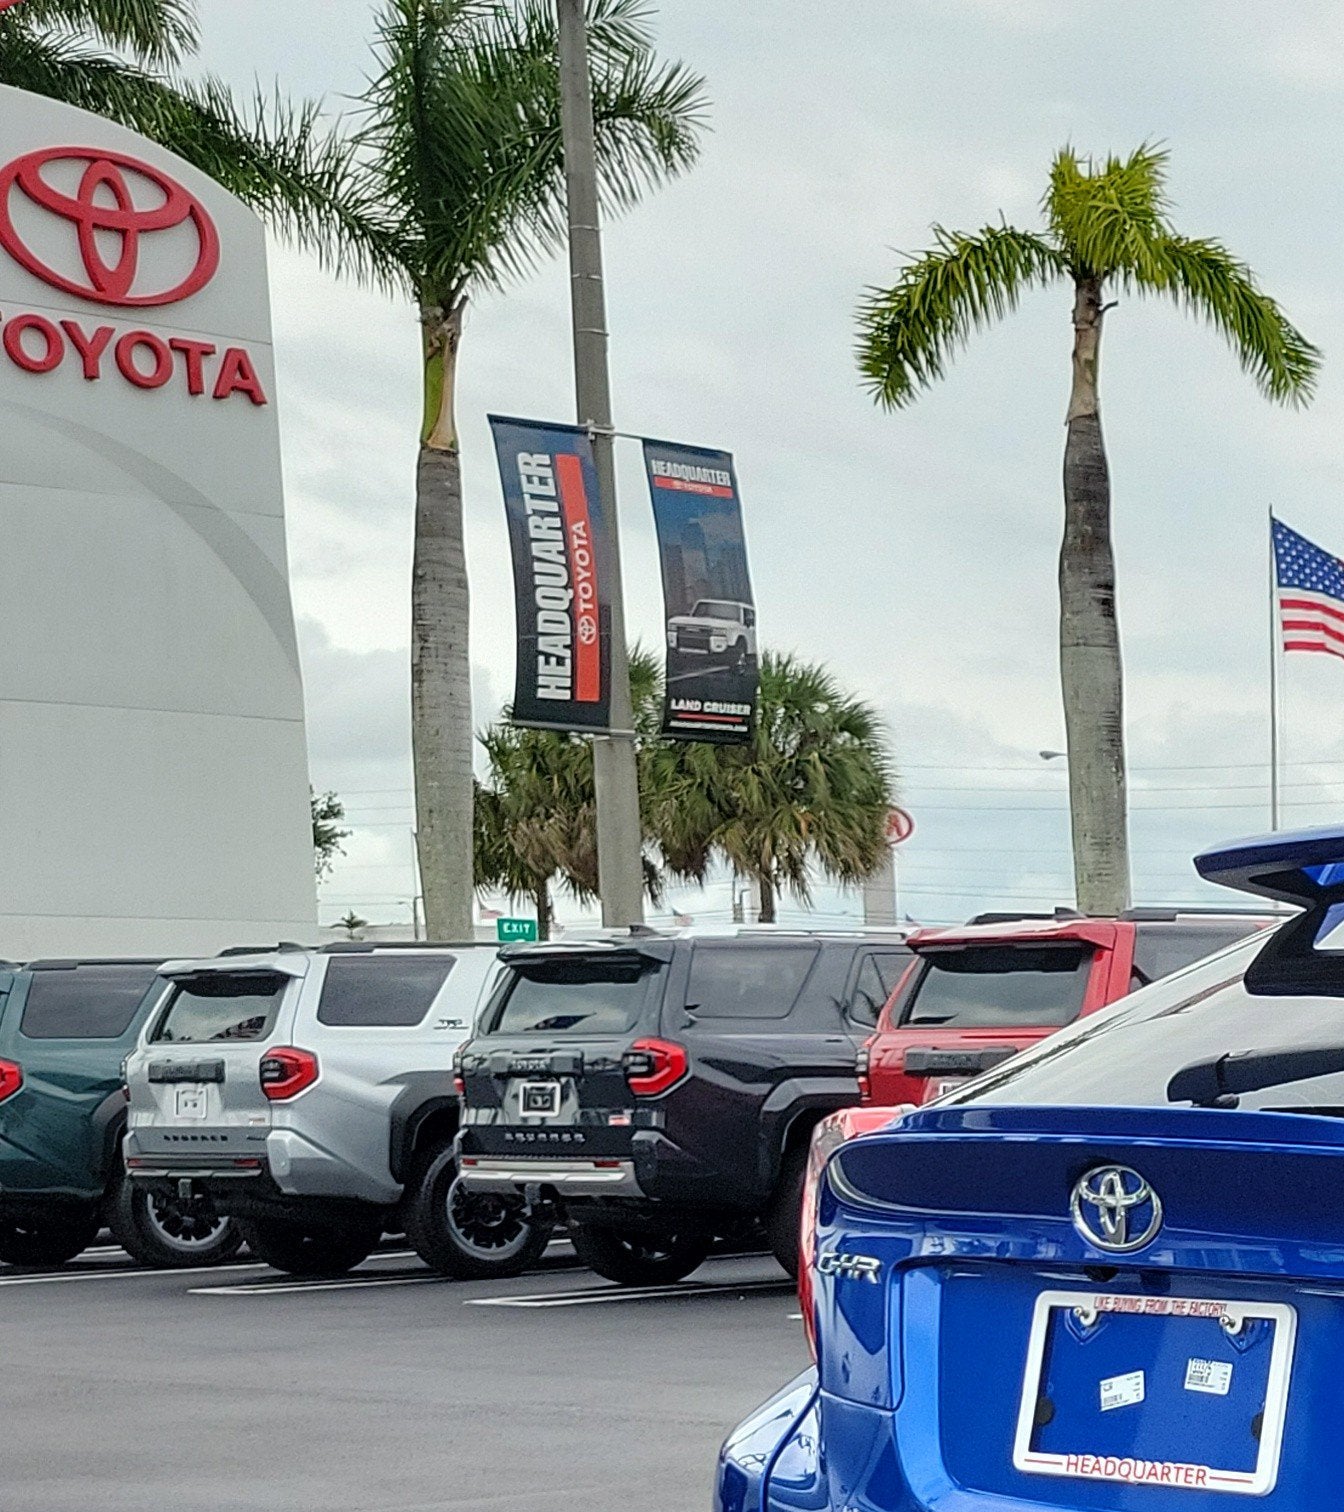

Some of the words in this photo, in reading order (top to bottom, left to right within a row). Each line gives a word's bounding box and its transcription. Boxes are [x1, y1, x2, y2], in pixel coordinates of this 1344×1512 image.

[0, 312, 267, 405] OYOTA
[651, 459, 731, 487] HEADQUARTER
[517, 451, 573, 700] HEADQUARTER
[571, 520, 596, 612] TOYOTA
[671, 698, 702, 711] LAND
[703, 701, 751, 716] CRUISER
[503, 922, 530, 934] EXIT
[1066, 1455, 1208, 1486] HEADQUARTER
